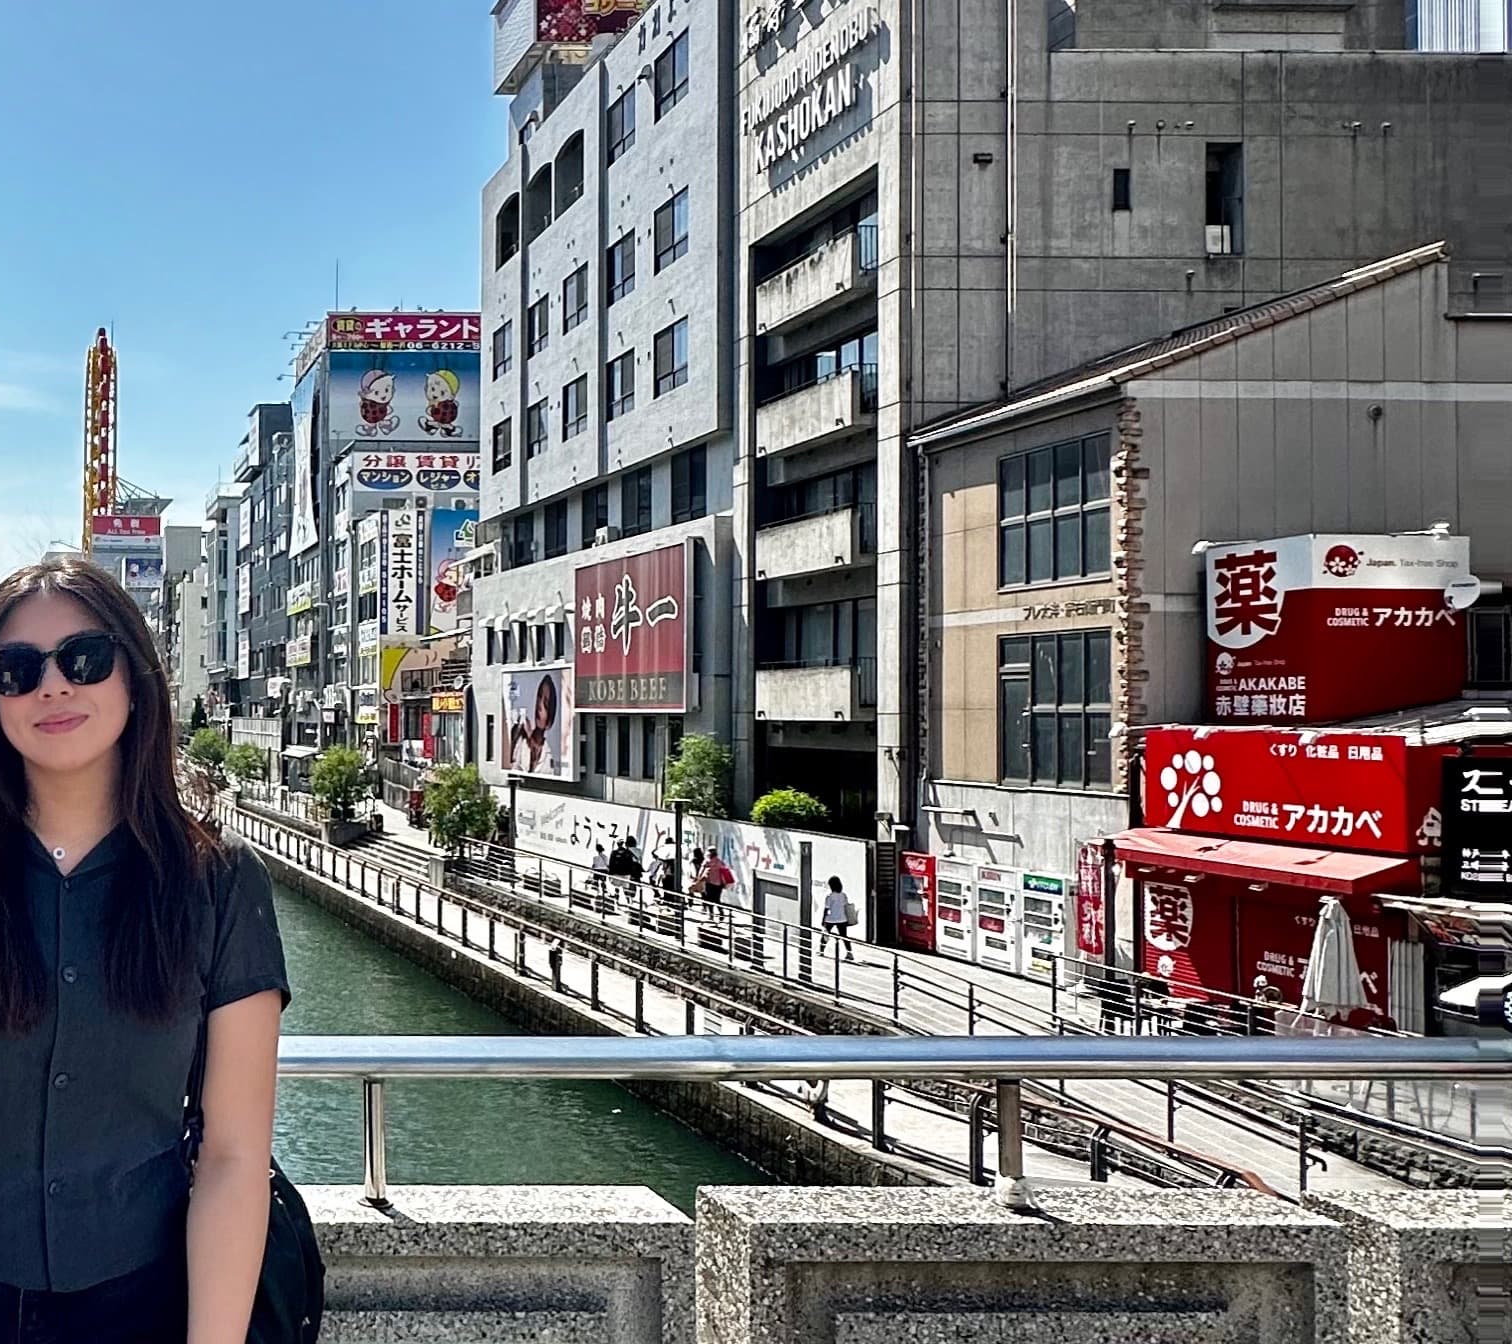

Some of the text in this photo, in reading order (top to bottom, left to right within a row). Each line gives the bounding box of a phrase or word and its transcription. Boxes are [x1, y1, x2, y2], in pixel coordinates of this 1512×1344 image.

[755, 63, 856, 174] KASHOKAN
[365, 317, 479, 339] ギャラント
[360, 471, 410, 483] マンション
[419, 471, 460, 483] レジャー
[1215, 549, 1279, 636] 薬
[1335, 607, 1356, 617] DRUG
[1372, 606, 1456, 627] アカカベ
[1327, 617, 1369, 627] COSMETIC
[588, 677, 667, 701] KOBE BEEF
[1238, 676, 1306, 691] AKAKABE
[1269, 742, 1383, 761] くすり 化粧品 日用品
[1242, 800, 1279, 816] DRUG &
[1233, 814, 1279, 830] COSMETIC
[1282, 803, 1383, 839] アカカベ
[1264, 951, 1287, 963] DRUG
[1256, 960, 1295, 978] COSMETIC
